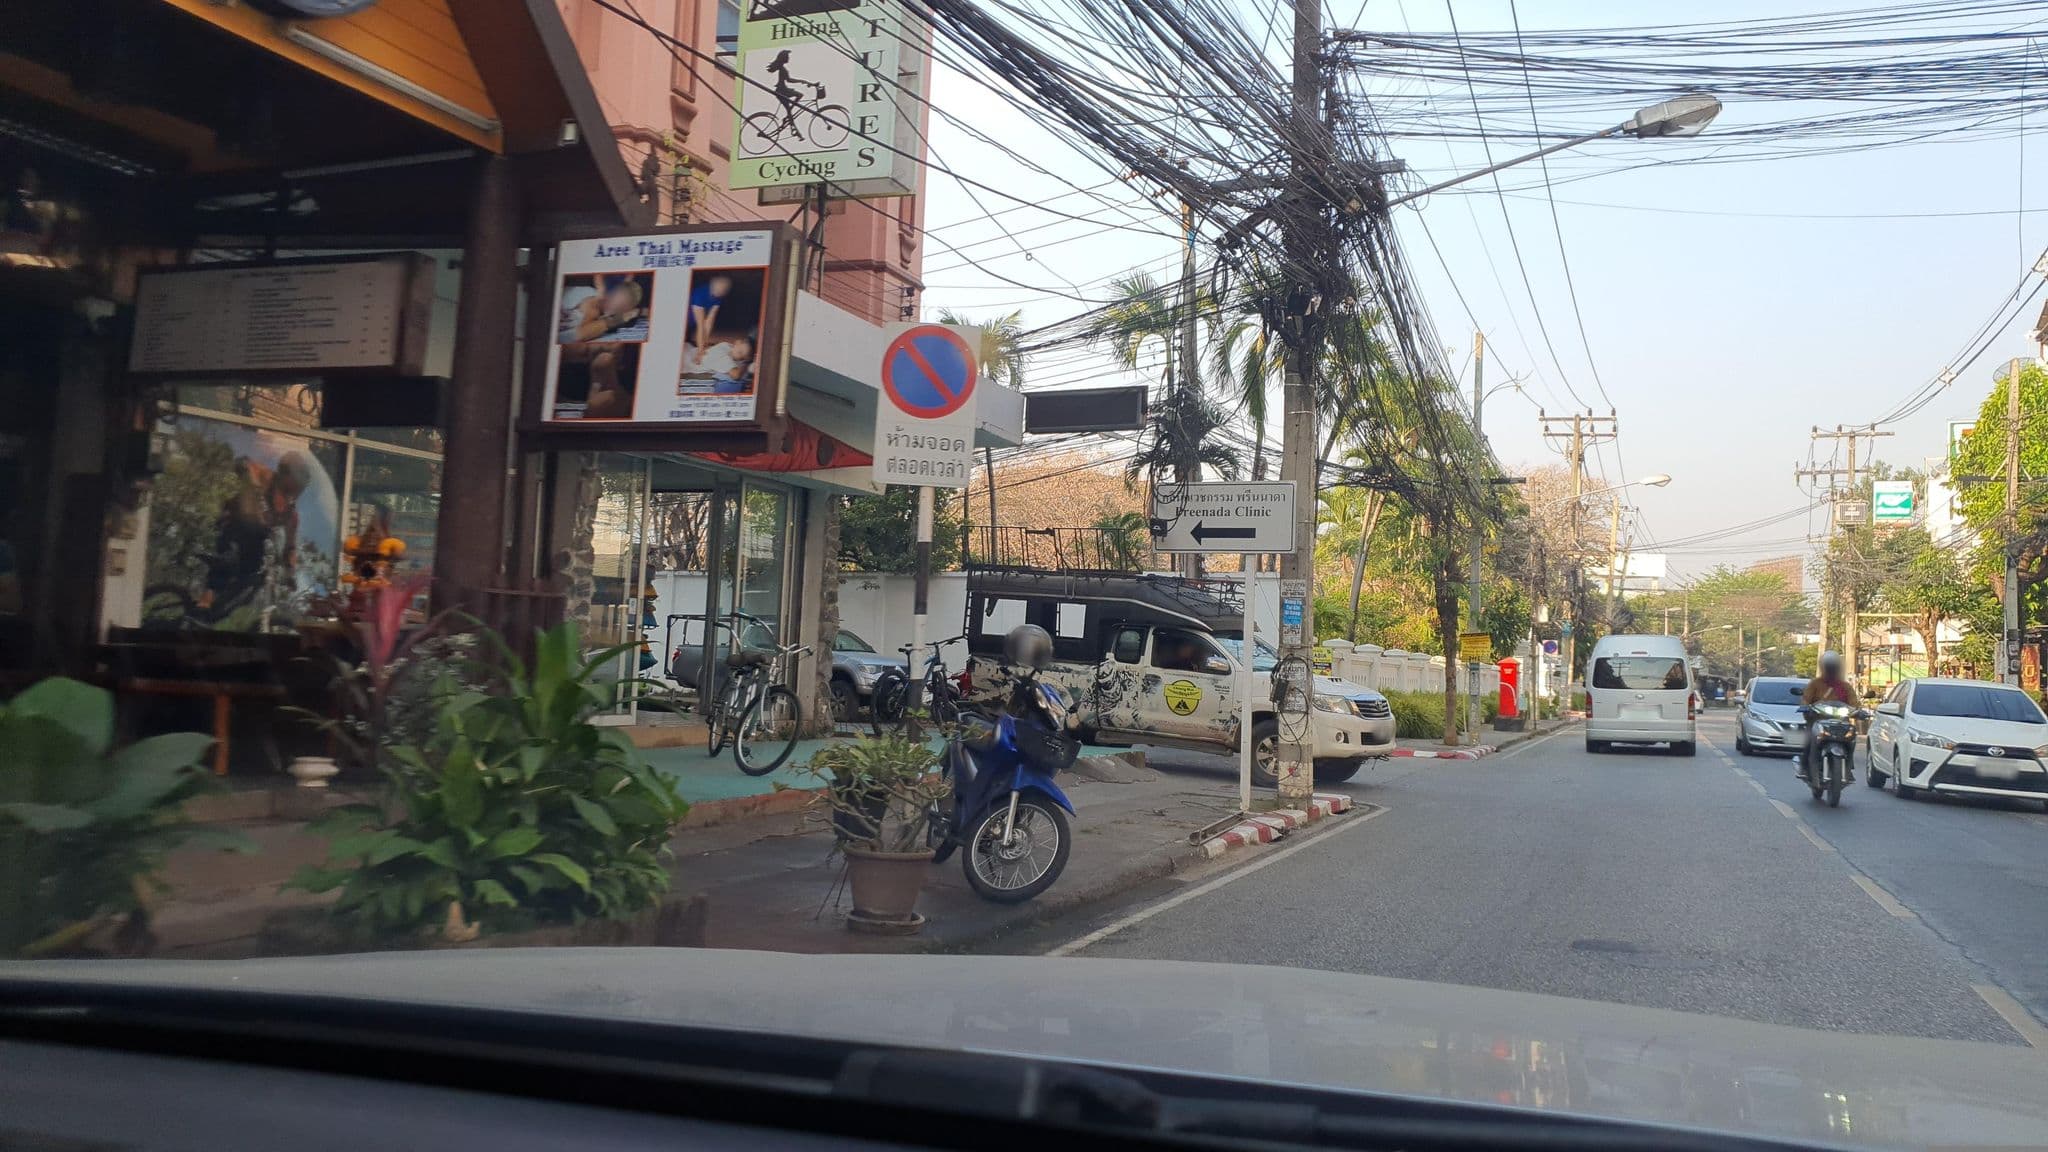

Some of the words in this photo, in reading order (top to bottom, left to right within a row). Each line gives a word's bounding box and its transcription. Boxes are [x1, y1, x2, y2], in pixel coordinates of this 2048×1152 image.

[771, 19, 841, 41] Hiking
[759, 158, 836, 182] Cycling
[594, 243, 631, 258] Aree
[637, 240, 673, 256] Thai
[678, 238, 744, 254] Massage
[886, 425, 966, 453] ห้ามจอด
[1175, 506, 1231, 518] Preenada
[1234, 505, 1272, 518] Clinic
